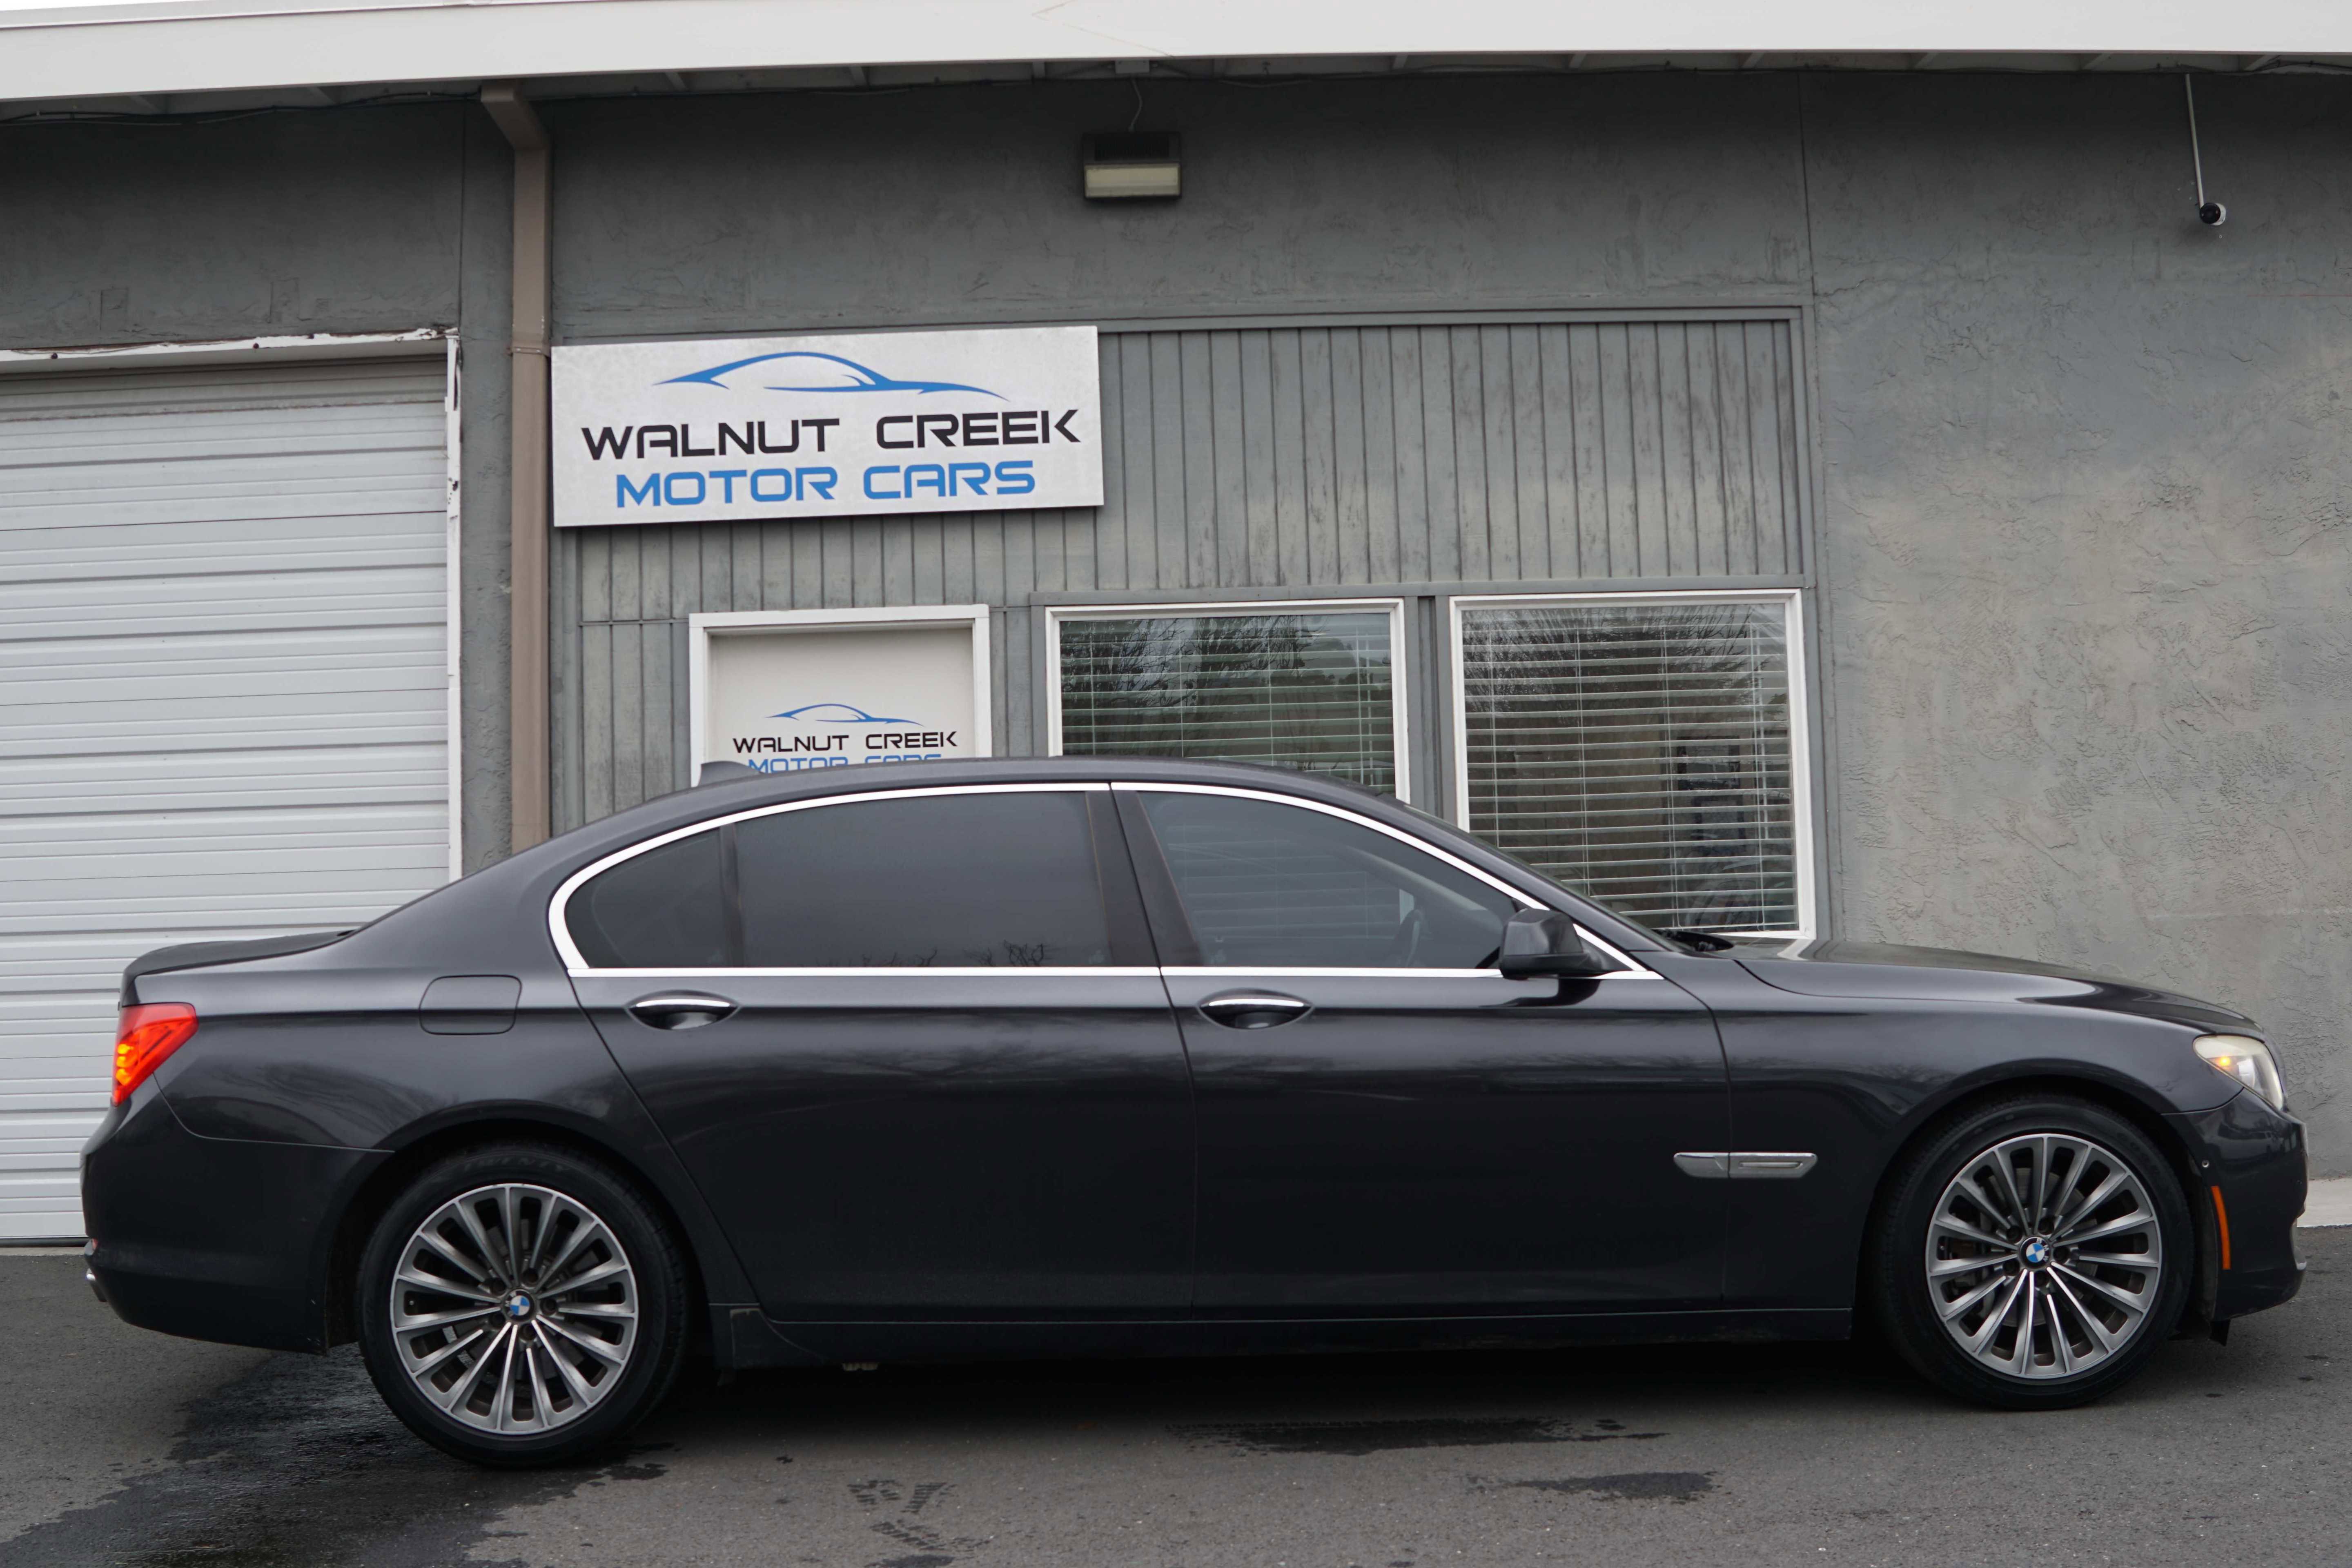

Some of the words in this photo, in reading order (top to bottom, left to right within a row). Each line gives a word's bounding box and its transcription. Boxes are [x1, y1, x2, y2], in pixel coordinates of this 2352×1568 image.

[581, 418, 840, 461] WALNUT
[876, 410, 1080, 450] CREEK
[616, 466, 840, 508] MOTOR
[863, 459, 1036, 500] CARS
[733, 735, 849, 754] WALNUT
[865, 731, 958, 750] CREEK
